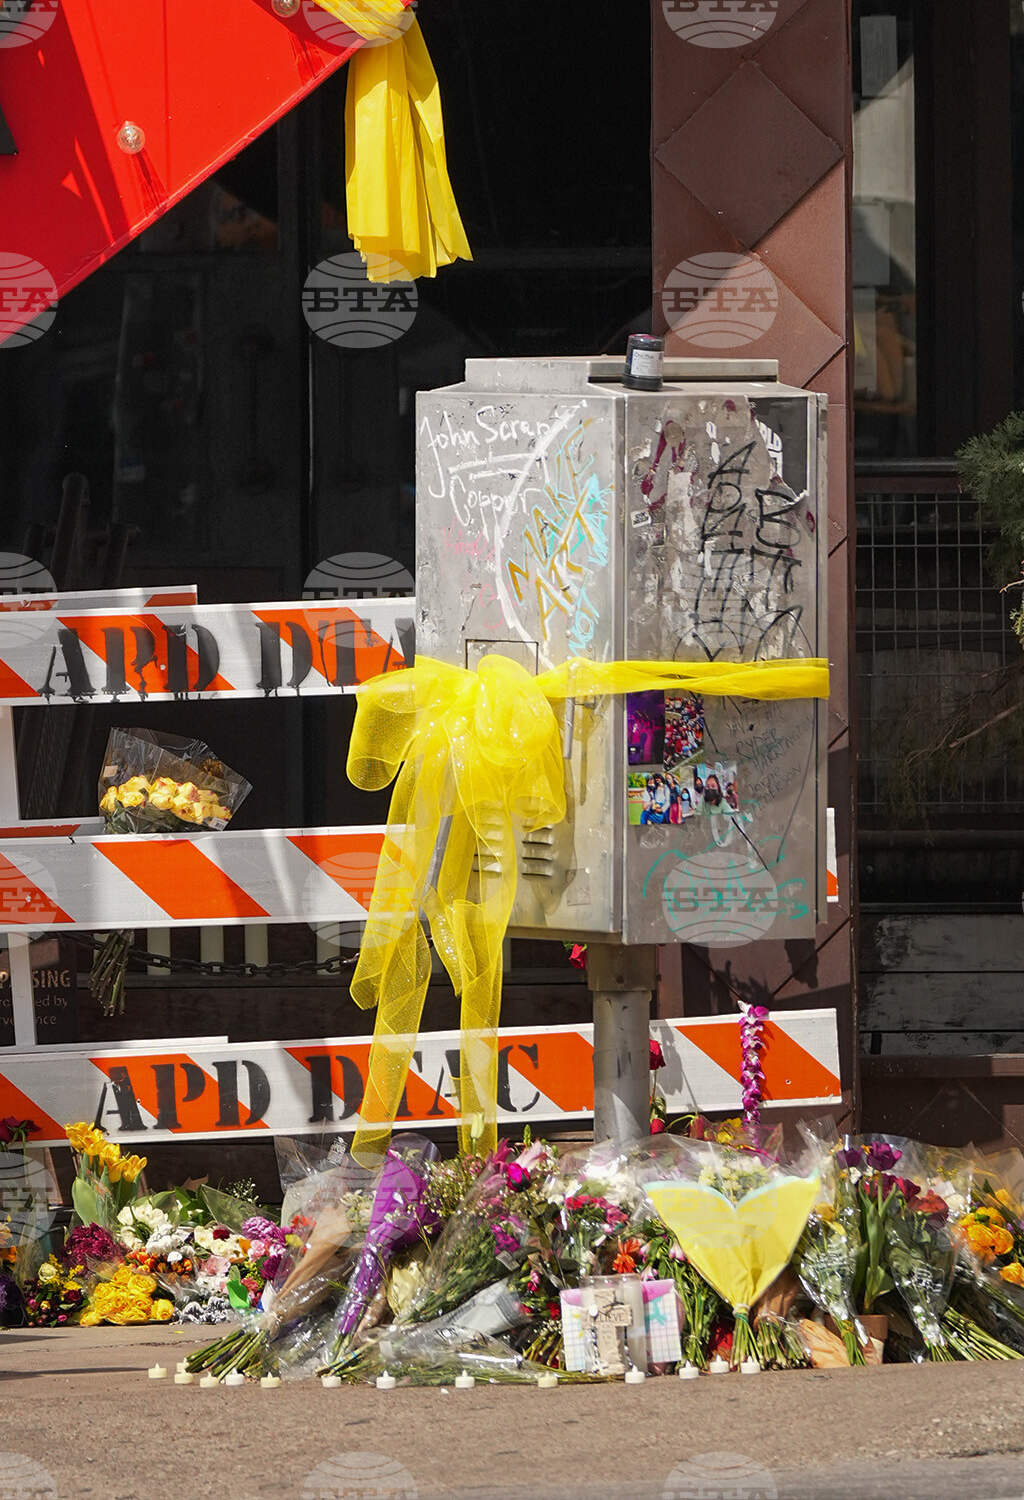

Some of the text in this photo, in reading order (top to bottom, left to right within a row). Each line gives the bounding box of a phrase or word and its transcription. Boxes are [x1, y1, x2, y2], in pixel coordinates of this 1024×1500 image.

[37, 623, 220, 698] APD
[54, 995, 68, 1008] by
[94, 1043, 541, 1133] APD DTAC
